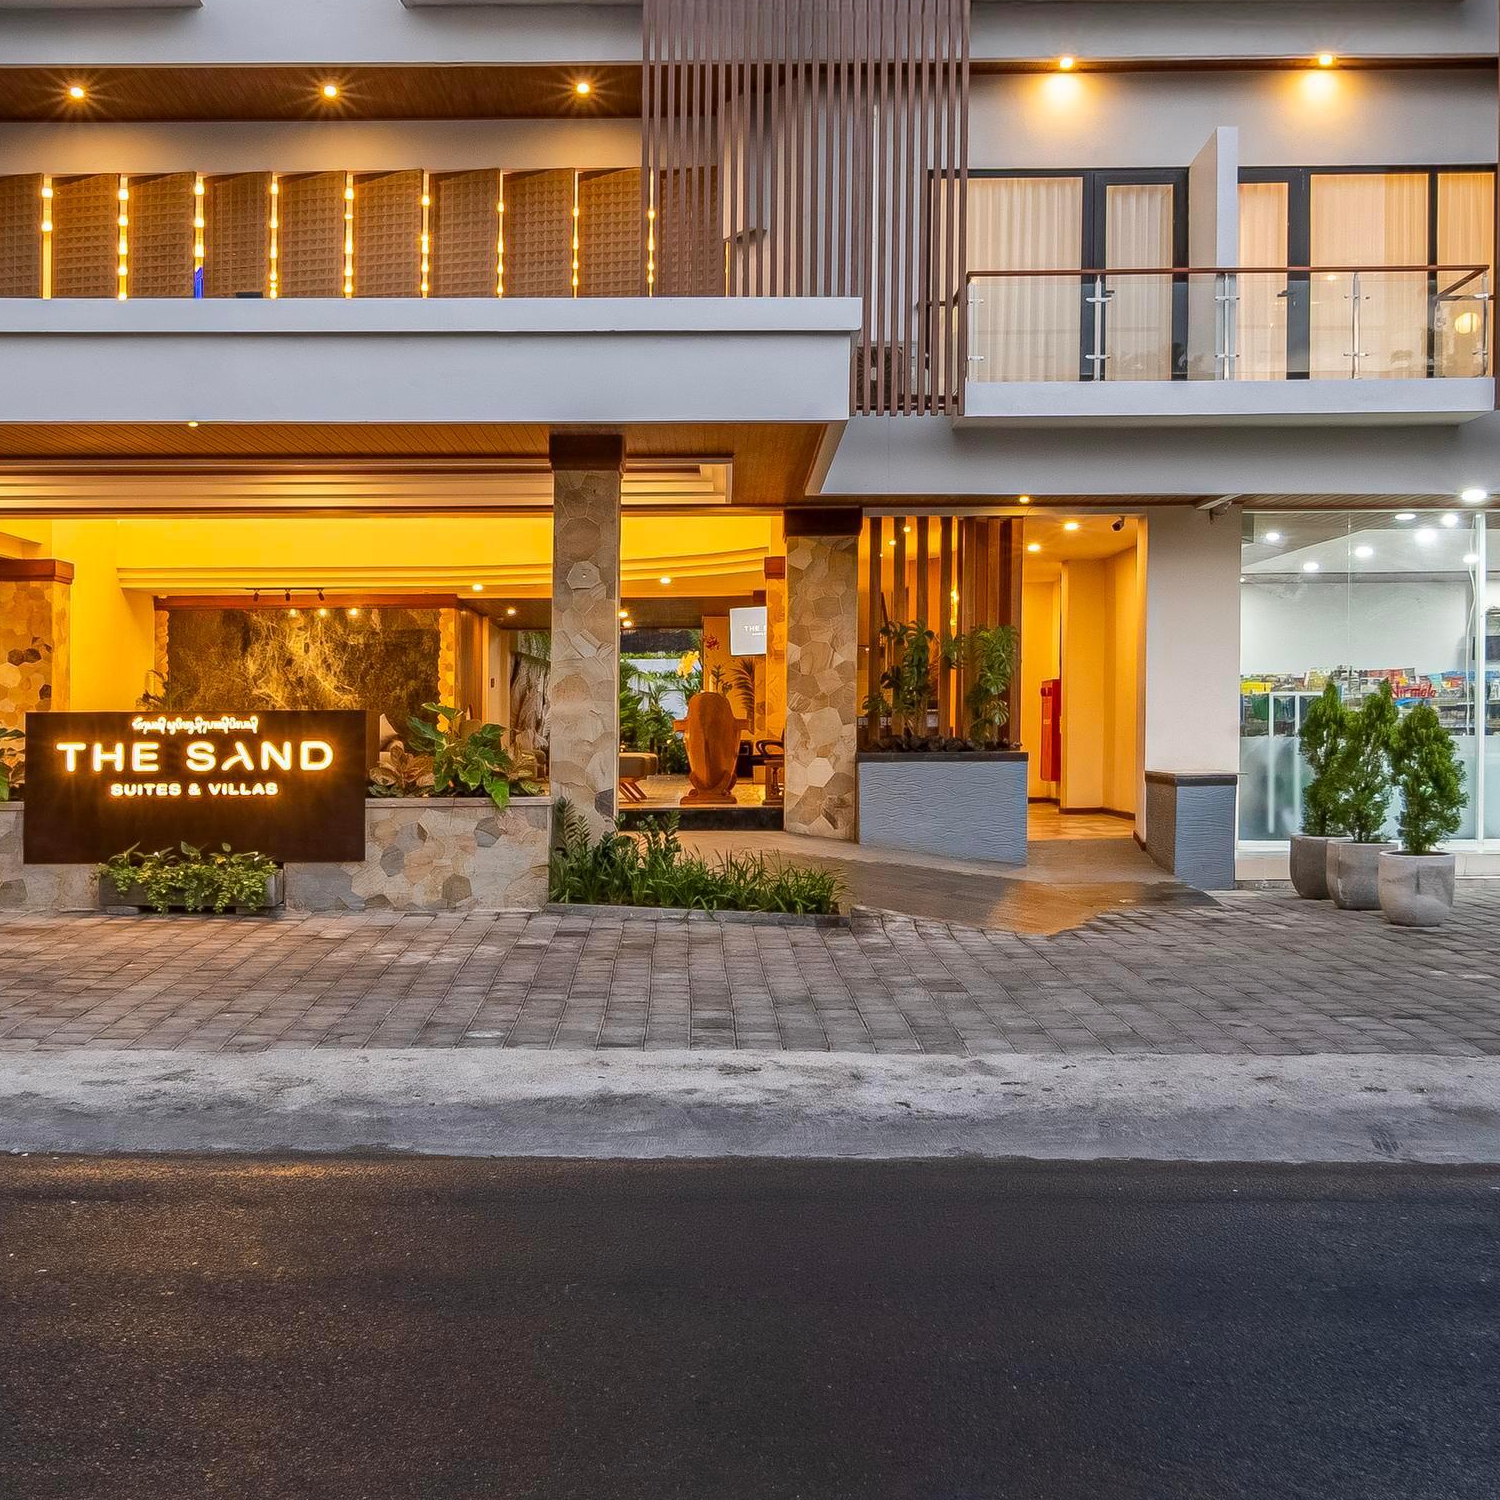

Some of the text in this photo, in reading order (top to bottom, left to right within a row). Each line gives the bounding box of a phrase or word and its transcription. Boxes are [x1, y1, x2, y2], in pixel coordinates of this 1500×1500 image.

[56, 740, 334, 772] THE SAND
[110, 782, 279, 797] SUITES & VILLAS
